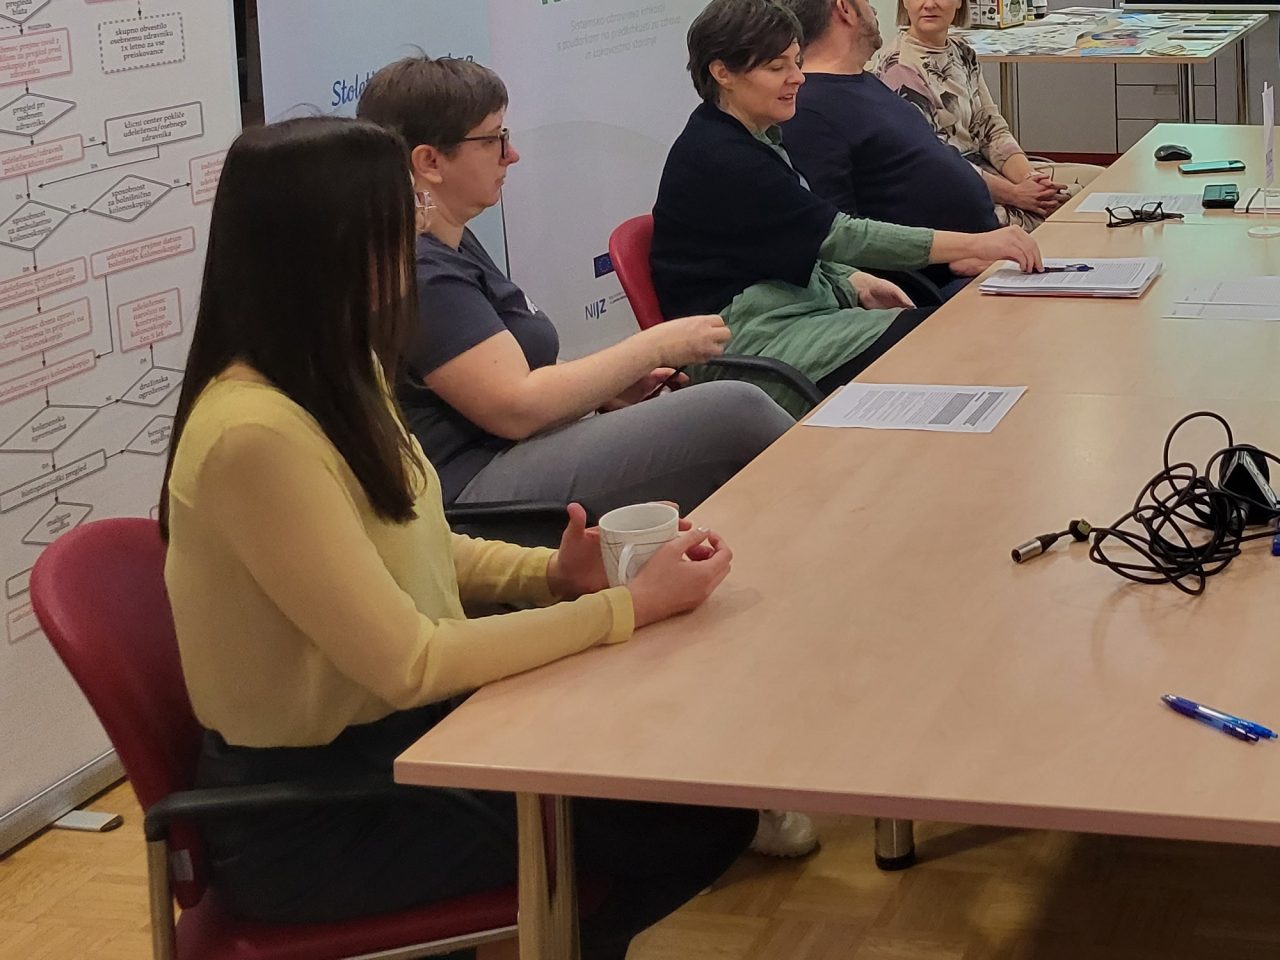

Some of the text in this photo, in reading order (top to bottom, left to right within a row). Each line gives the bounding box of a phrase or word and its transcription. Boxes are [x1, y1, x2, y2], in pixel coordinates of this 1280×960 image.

[115, 22, 167, 36] skupno obvestilo
[129, 42, 146, 50] letno
[123, 47, 164, 61] preiskovance
[13, 102, 45, 115] pregled pri
[124, 111, 185, 129] klicni center pokliče
[111, 184, 146, 196] sposobnost
[585, 298, 607, 320] NIJZ
